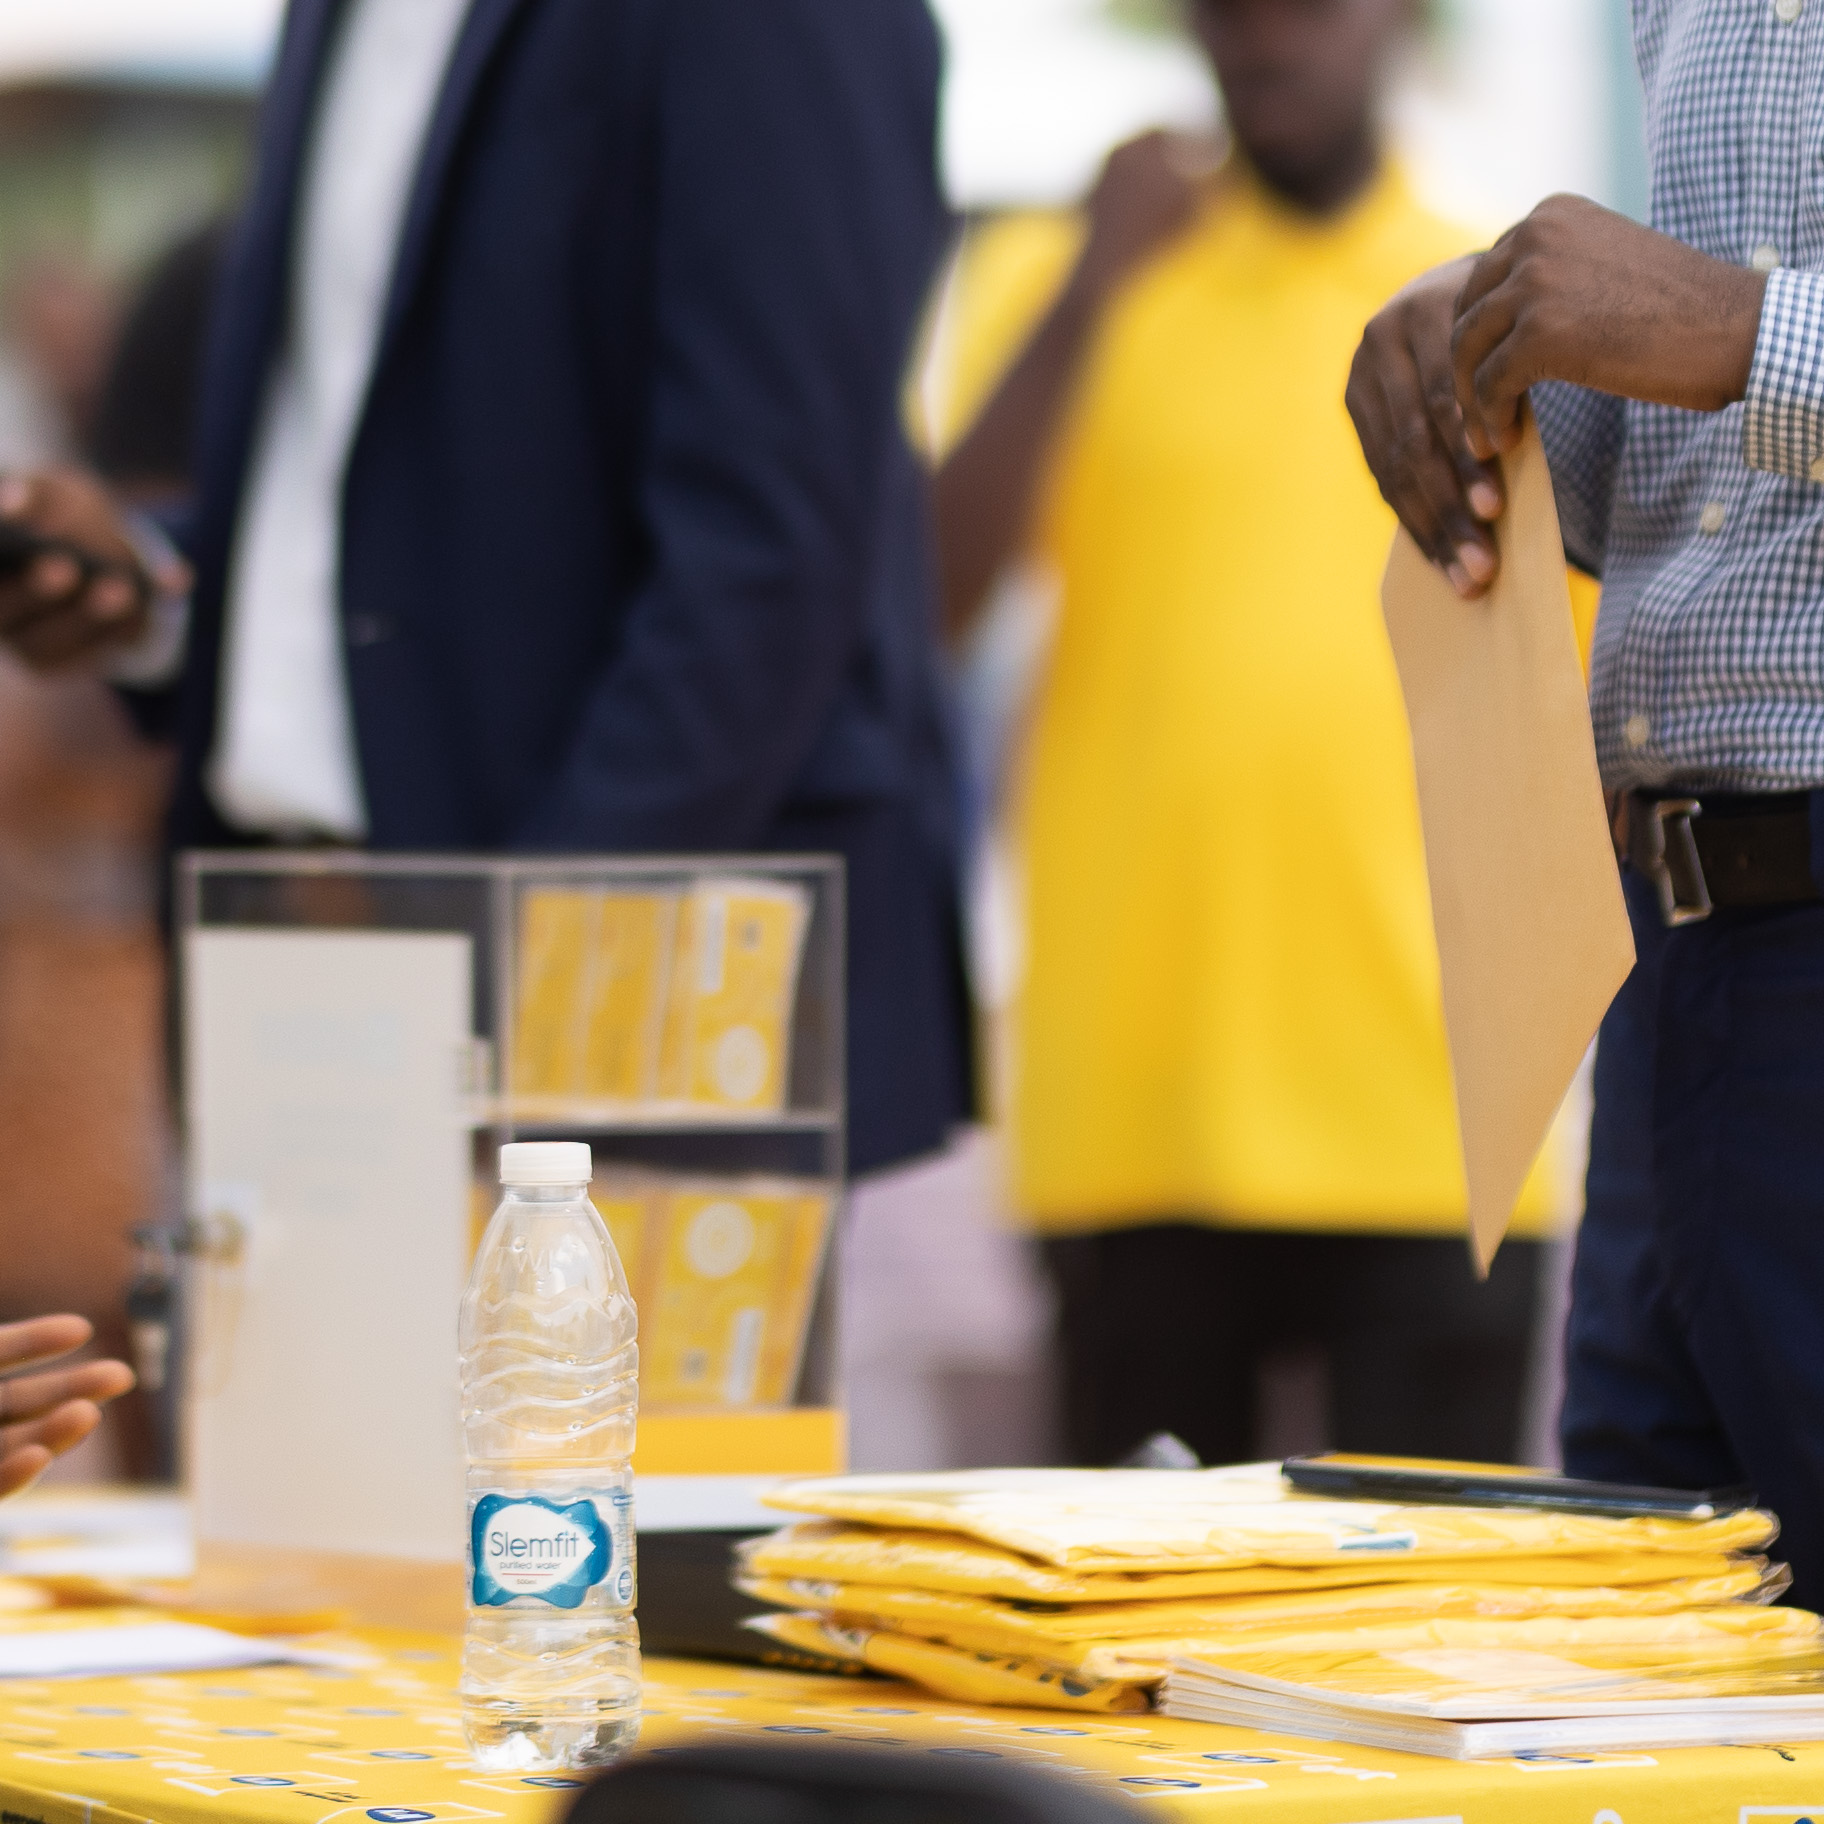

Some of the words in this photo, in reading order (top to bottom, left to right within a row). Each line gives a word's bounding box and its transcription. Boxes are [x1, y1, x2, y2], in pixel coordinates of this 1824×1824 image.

[490, 1531, 579, 1558] Slemfit
[499, 1561, 533, 1570] purified
[536, 1561, 562, 1569] water
